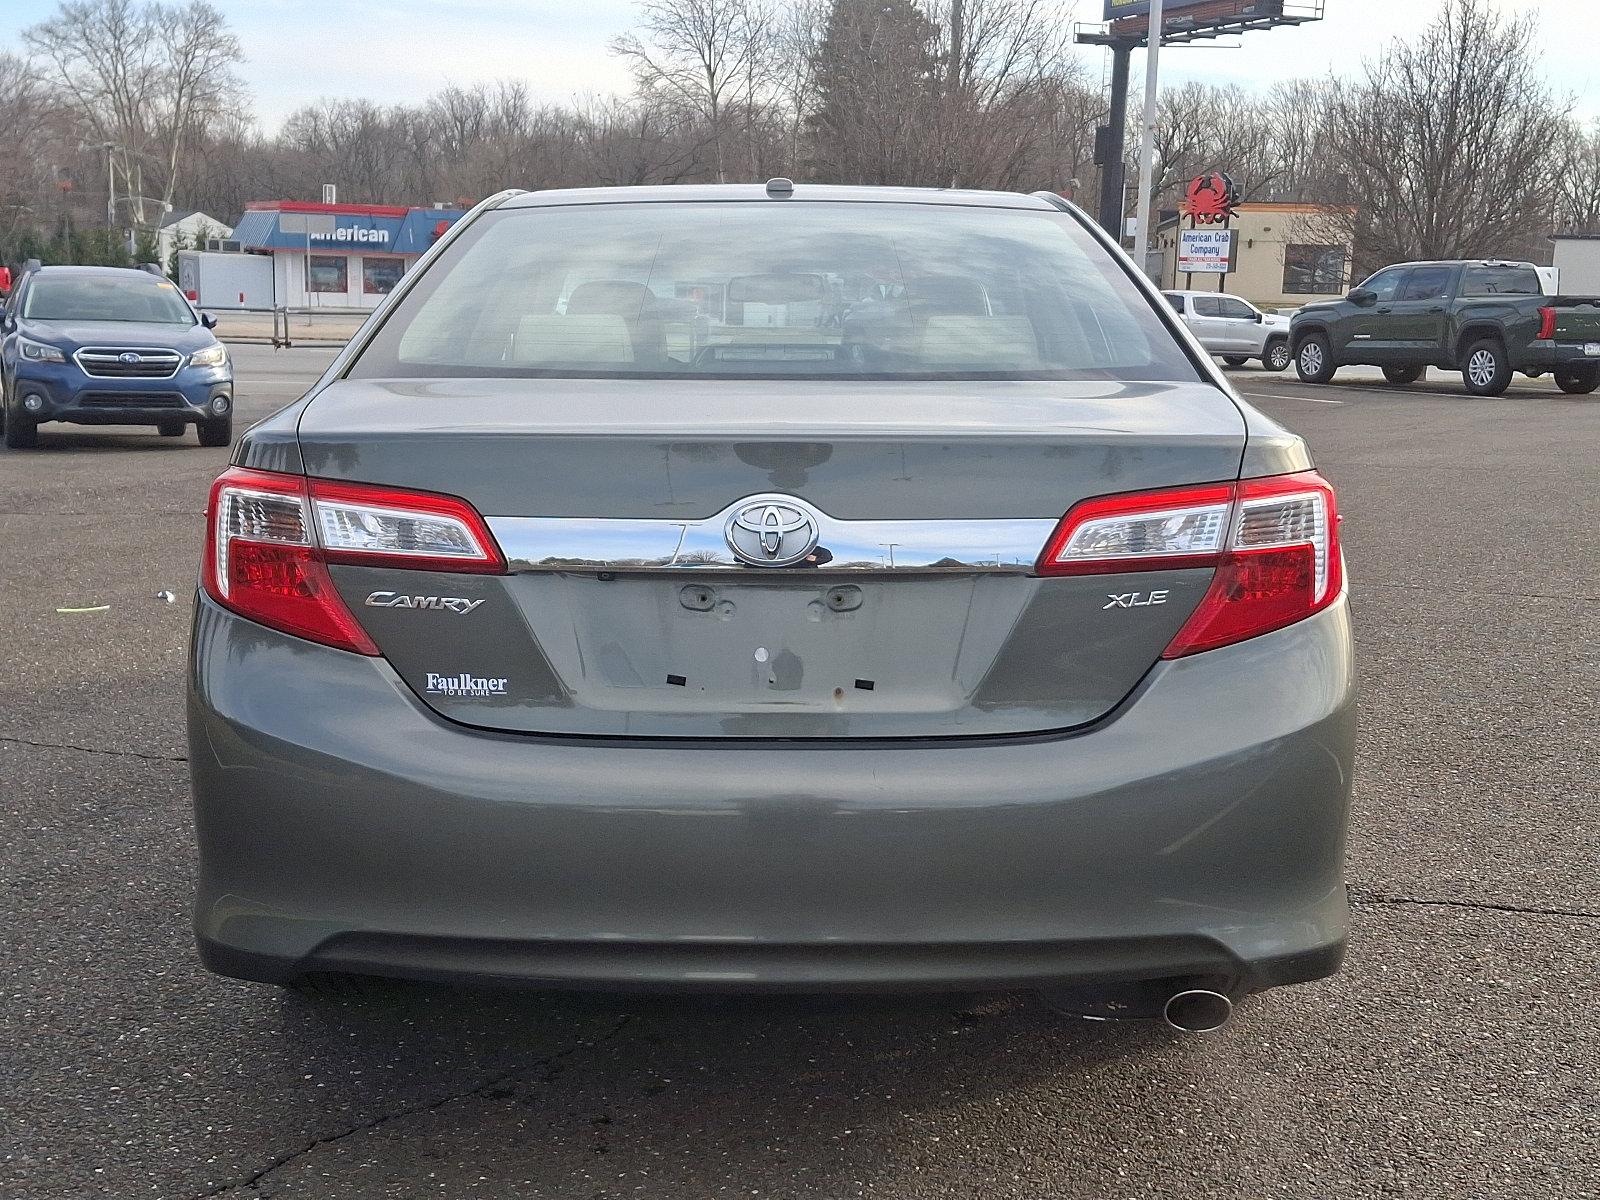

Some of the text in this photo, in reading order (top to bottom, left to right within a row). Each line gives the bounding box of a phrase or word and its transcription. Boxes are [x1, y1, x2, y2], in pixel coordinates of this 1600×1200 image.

[1182, 232, 1229, 242] American Crab
[1190, 244, 1220, 256] Company
[365, 591, 486, 614] CAMRY
[1102, 589, 1170, 610] XLE
[426, 673, 508, 691] Faulkner
[470, 689, 490, 697] SURE
